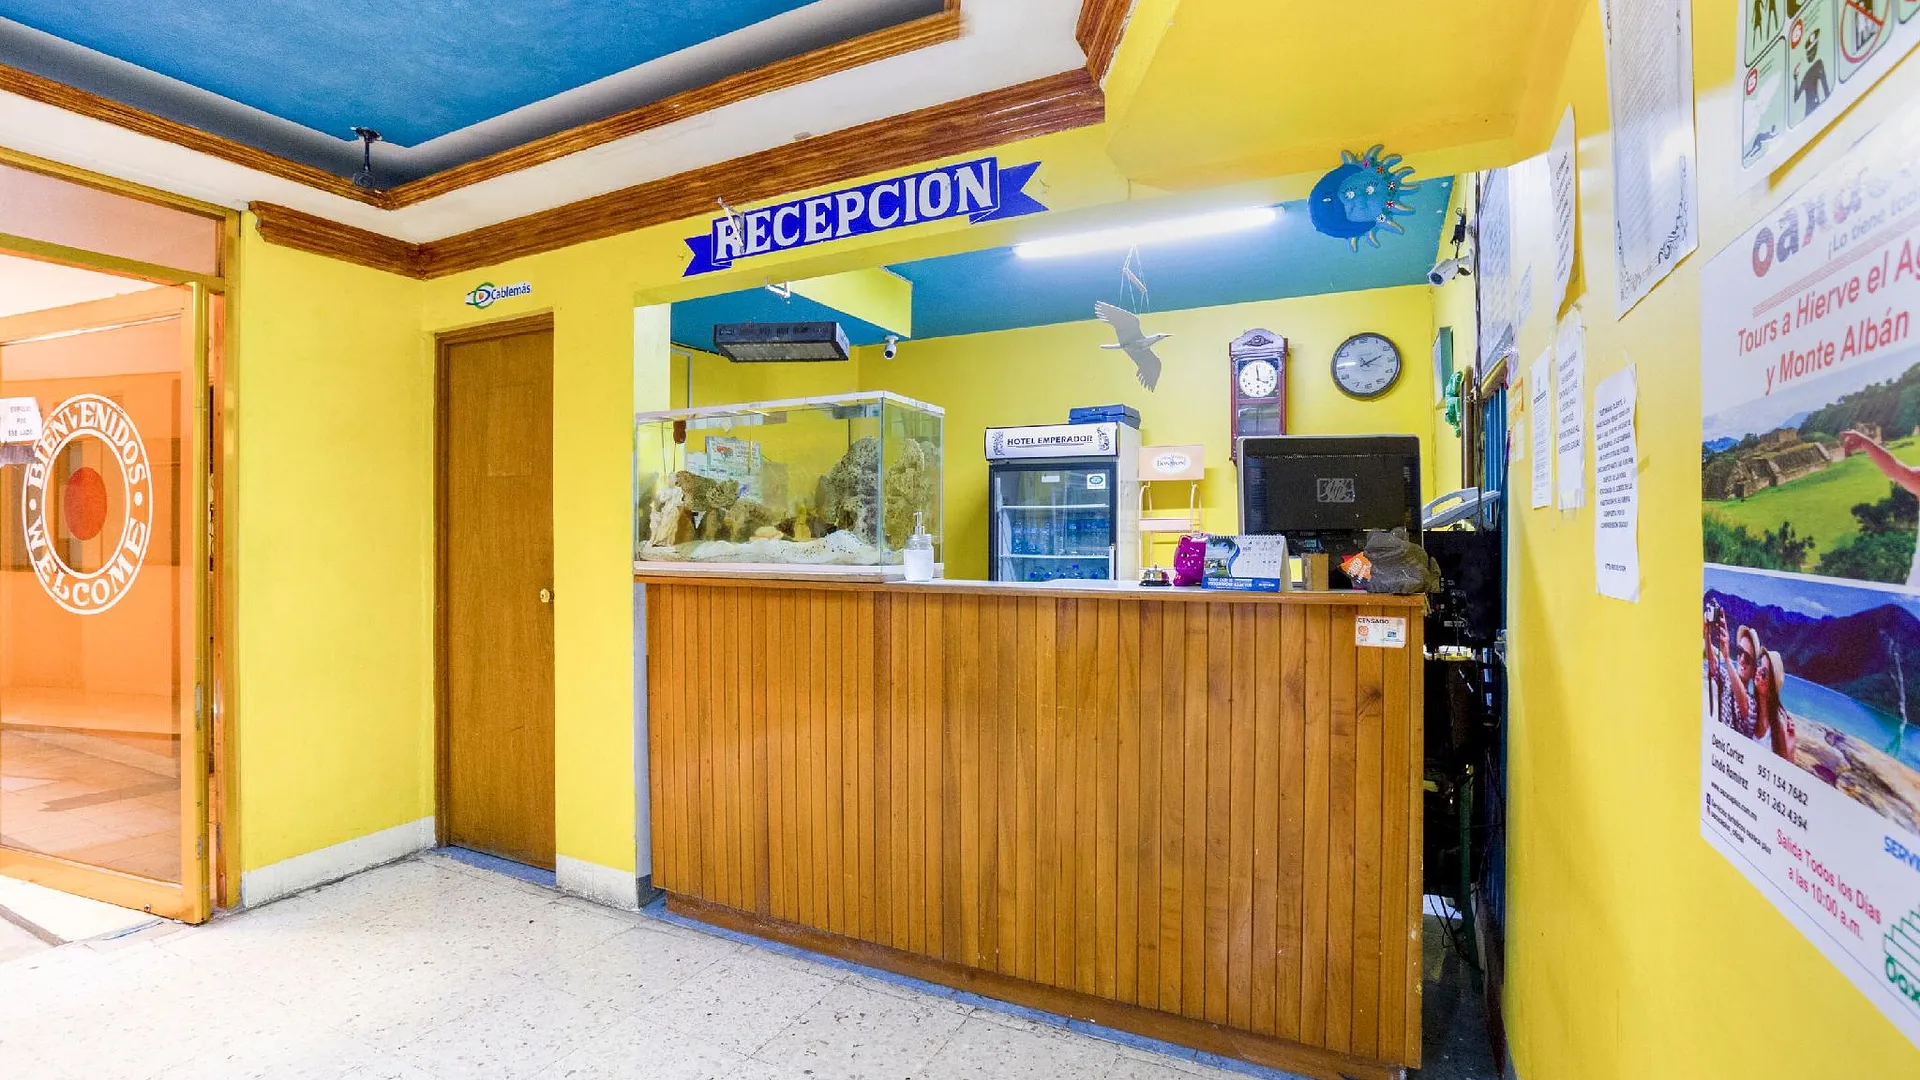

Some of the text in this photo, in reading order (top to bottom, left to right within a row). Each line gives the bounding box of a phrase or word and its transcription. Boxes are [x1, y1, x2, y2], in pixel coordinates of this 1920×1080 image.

[715, 161, 993, 260] RECEPCION
[491, 282, 531, 300] Cablemás
[1738, 318, 1778, 357] Tours
[1782, 311, 1791, 336] a
[1796, 276, 1860, 329] Hierve
[1867, 250, 1889, 294] el
[1765, 306, 1910, 396] y Monte Albán
[28, 400, 147, 490] BIENVENIDOS
[1007, 434, 1093, 447] HOTEL EMPERADOR
[28, 516, 147, 607] WELCOME
[1357, 617, 1390, 625] CENSADO
[1757, 764, 1770, 781] 951
[1773, 774, 1786, 791] 154
[1757, 787, 1770, 806] 951
[1772, 797, 1786, 817] 262
[1777, 828, 1803, 862] Salida
[1805, 849, 1835, 888] Todos
[1837, 874, 1853, 903] los
[1788, 867, 1794, 881] a
[1795, 868, 1809, 893] las
[1811, 882, 1838, 918] 10:00
